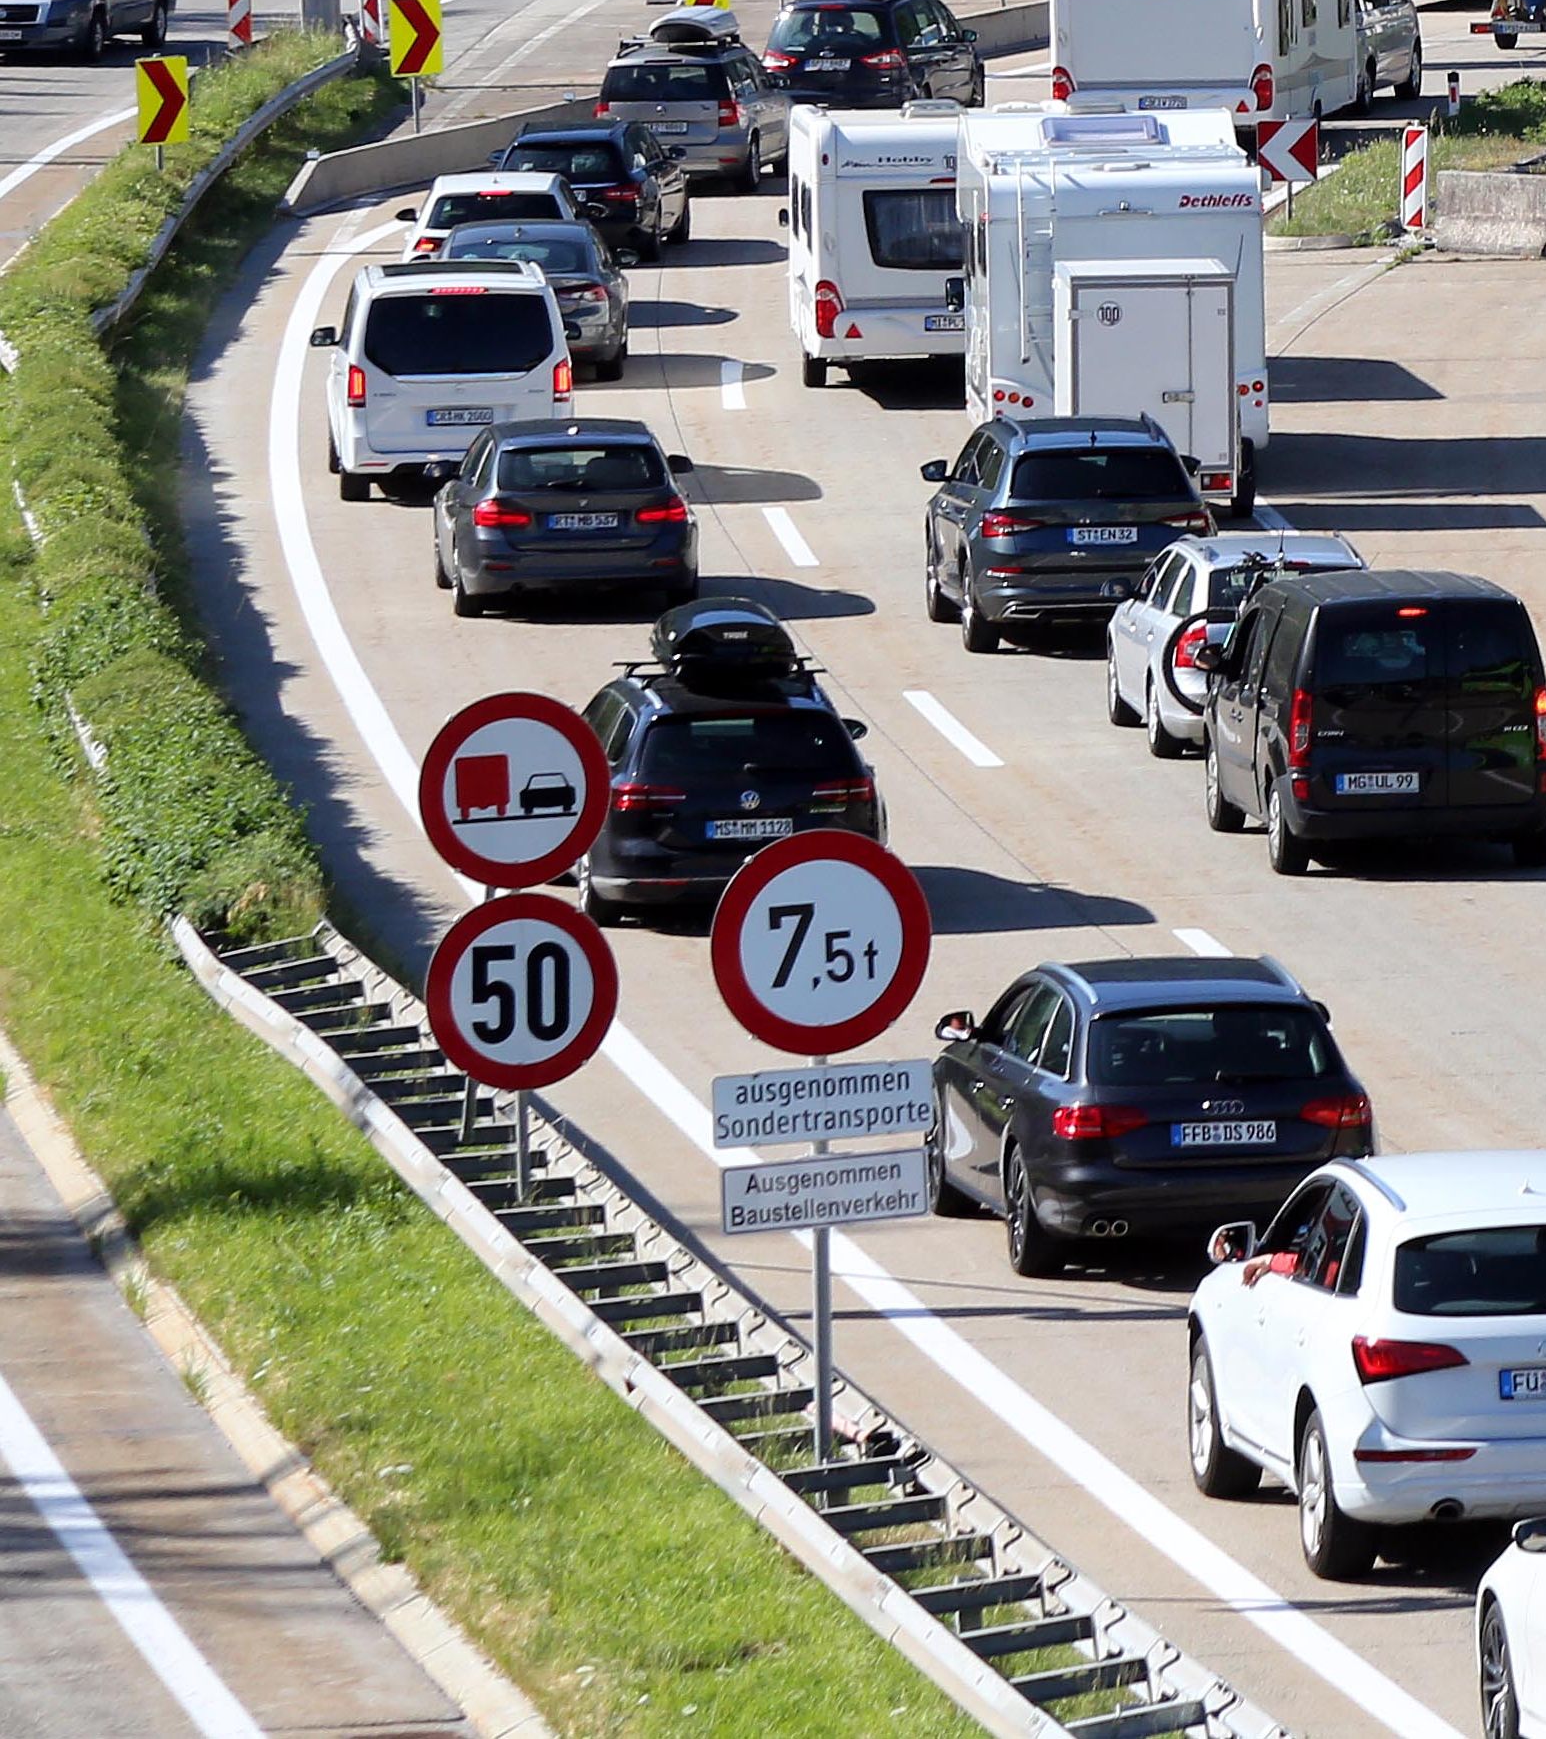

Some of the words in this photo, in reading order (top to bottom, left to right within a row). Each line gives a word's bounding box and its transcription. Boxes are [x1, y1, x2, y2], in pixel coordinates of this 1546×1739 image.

[1179, 193, 1254, 210] Dethleffs
[1101, 306, 1121, 323] 100
[1076, 529, 1094, 544] ST
[1101, 528, 1119, 543] EN
[1120, 527, 1135, 542] 32
[1347, 773, 1368, 791] MG
[1374, 773, 1393, 790] UL
[1396, 773, 1415, 790] 99
[471, 940, 571, 1045] 50
[735, 1066, 911, 1108] ausgenommen
[716, 1097, 932, 1141] Sondertransporte
[1180, 1124, 1213, 1144] FFB
[1222, 1123, 1242, 1143] DS
[1245, 1121, 1276, 1141] 986
[745, 1160, 902, 1195] Ausgenommen
[729, 1188, 923, 1229] Baustellenverkehr
